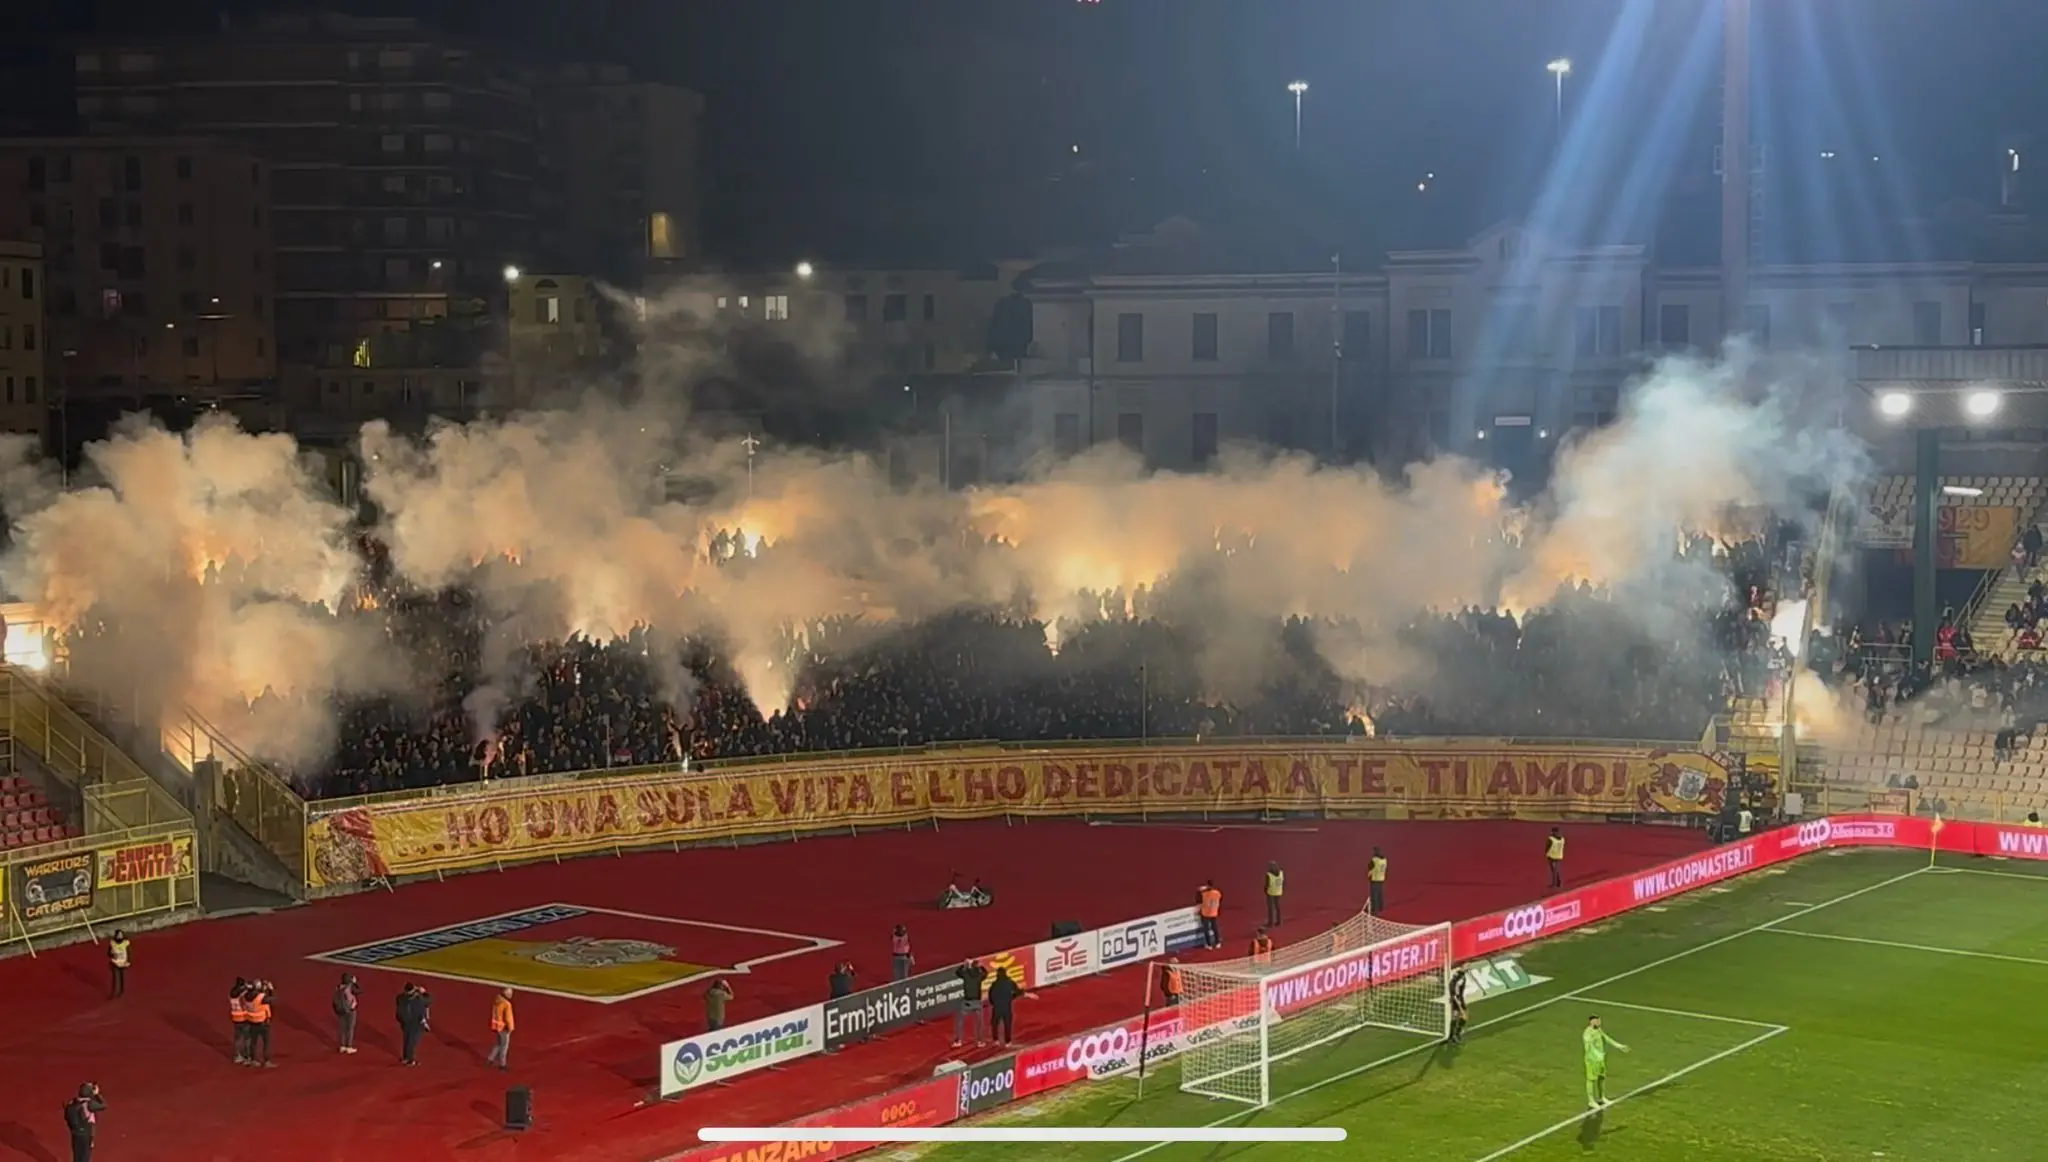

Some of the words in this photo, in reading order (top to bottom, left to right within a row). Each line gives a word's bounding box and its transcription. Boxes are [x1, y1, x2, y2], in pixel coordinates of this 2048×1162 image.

[525, 793, 623, 840] UNA
[637, 783, 756, 826] SOLA
[770, 774, 874, 815] VITA
[891, 771, 917, 806] E
[1042, 760, 1272, 800] DEDICATA
[1419, 761, 1469, 796] TI
[1487, 761, 1629, 797] AMO!
[1999, 831, 2048, 855] WW
[24, 854, 92, 878] WARRIORS
[1633, 844, 1755, 900] WWW.COOPMASTER.IT
[1504, 904, 1546, 939] coop
[1101, 920, 1159, 965] COSTA
[1267, 938, 1440, 1009] WWW.COOPMASTER.IT
[915, 985, 935, 998] Porte
[915, 998, 936, 1011] Porte
[826, 990, 912, 1040] Ermetika
[1026, 1058, 1065, 1079] MASTER
[1066, 1027, 1129, 1072] coop
[1092, 1056, 1130, 1076] GoldBet
[970, 1068, 1015, 1100] 00:00
